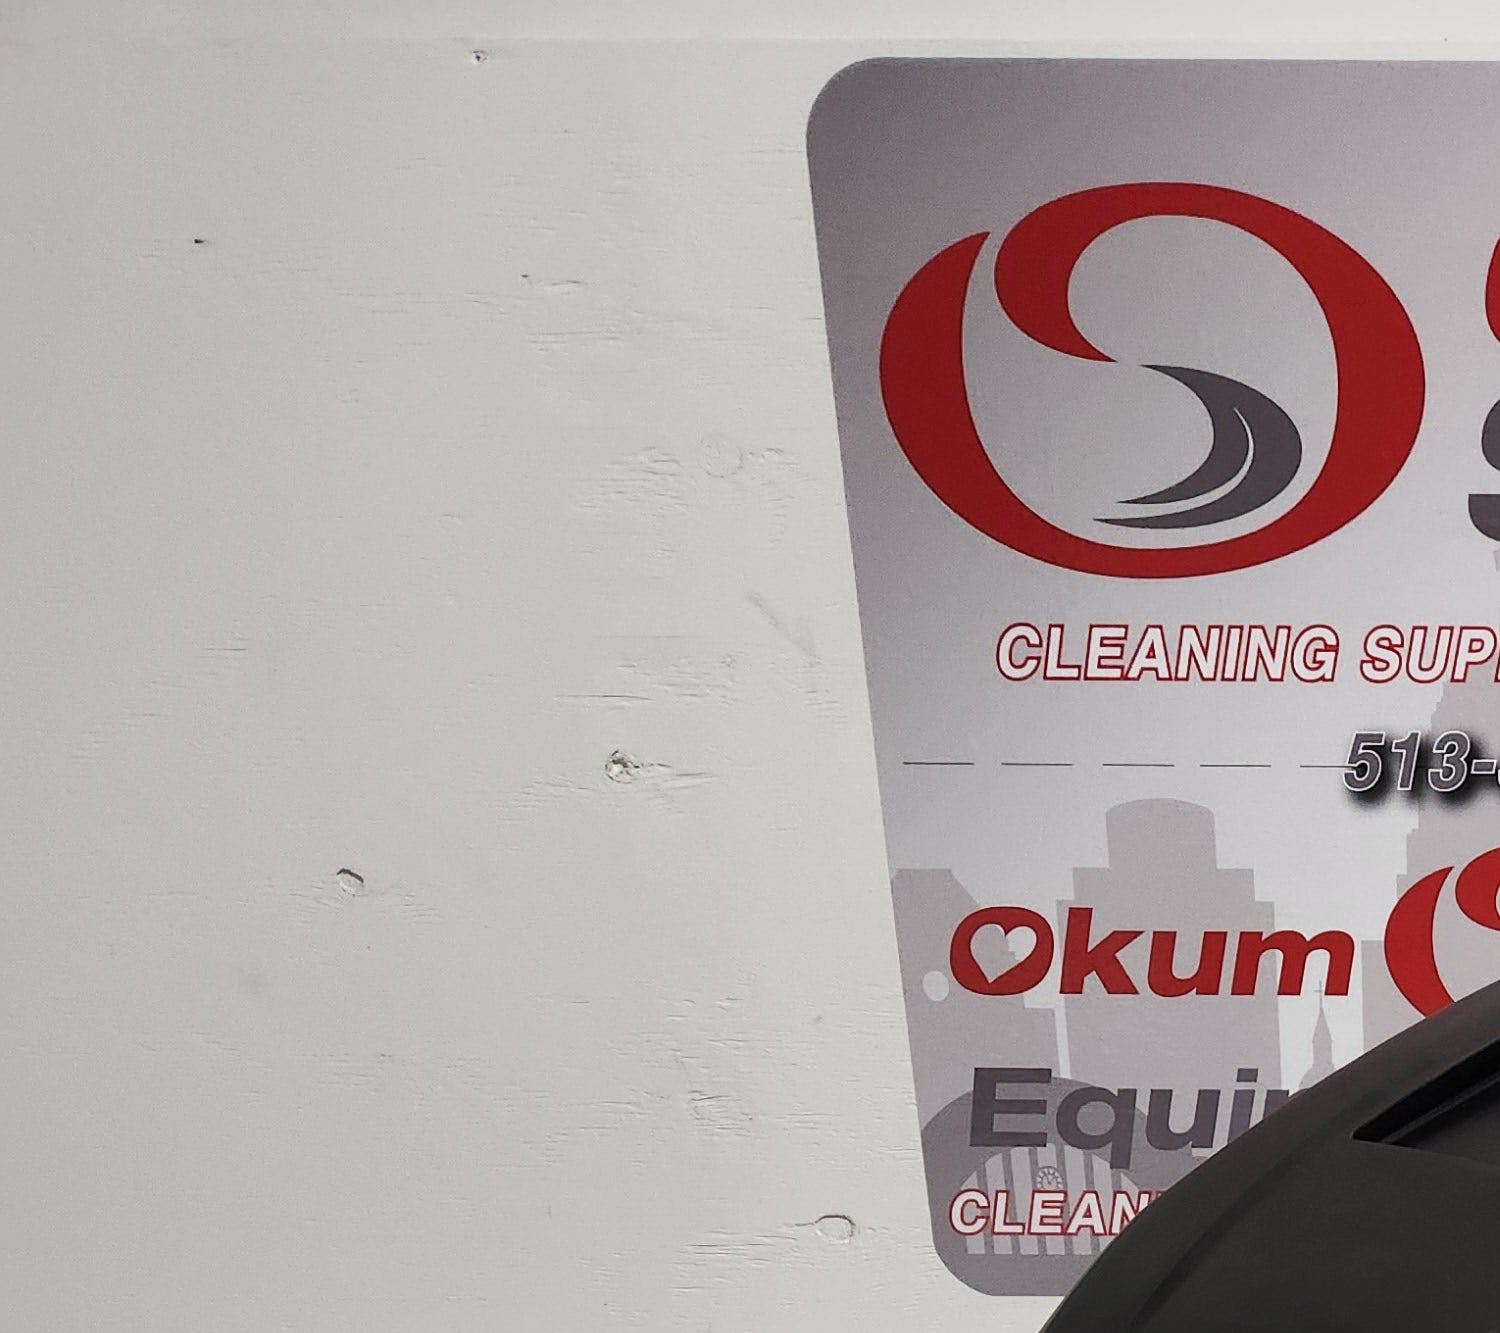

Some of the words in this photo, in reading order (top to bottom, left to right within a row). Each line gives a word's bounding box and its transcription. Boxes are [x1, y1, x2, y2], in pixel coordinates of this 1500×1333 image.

[996, 622, 1339, 682] CLEANING
[949, 906, 1356, 997] Okum
[969, 1067, 1302, 1169] Equi
